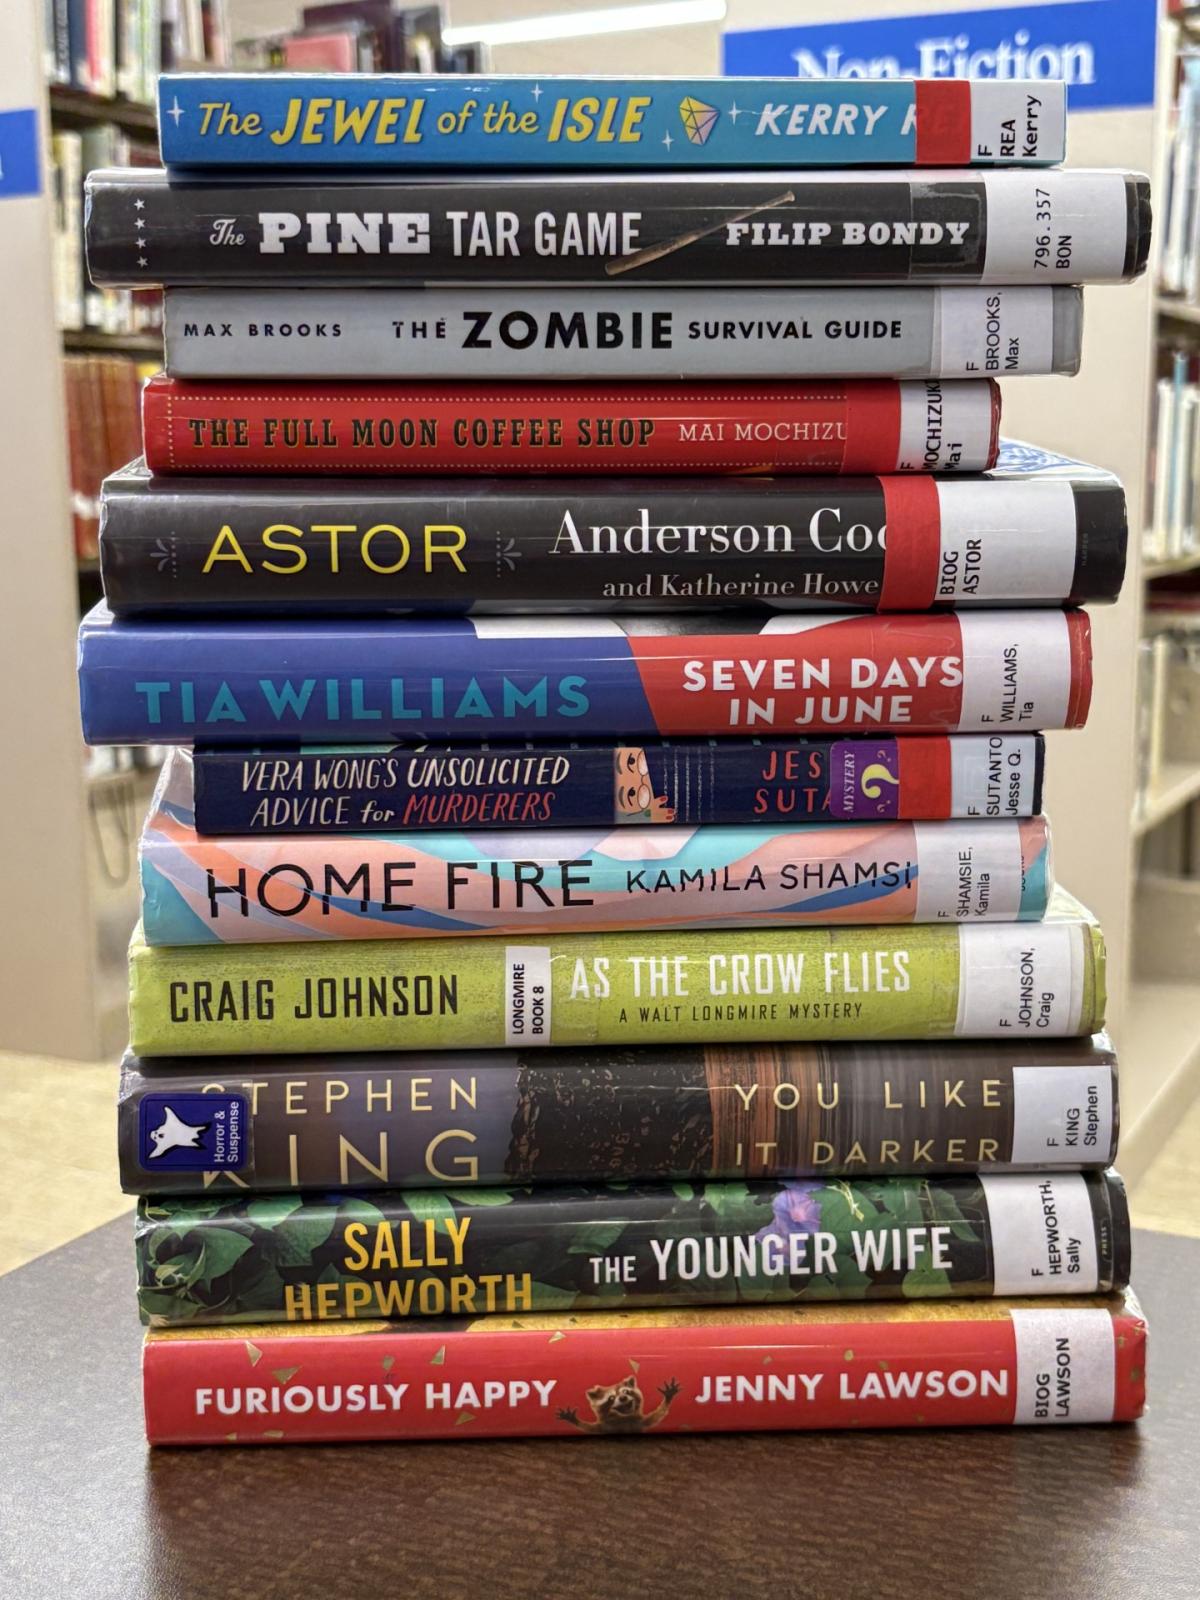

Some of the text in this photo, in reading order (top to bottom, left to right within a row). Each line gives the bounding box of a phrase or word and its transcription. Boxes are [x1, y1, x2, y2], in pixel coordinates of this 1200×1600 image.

[199, 96, 652, 145] The JEWEL of the ISLE
[755, 103, 888, 136] KERRY
[1001, 119, 1016, 157] REA
[1022, 94, 1042, 157] Kerry
[978, 144, 992, 157] F
[210, 211, 642, 257] The PINE TAR GAME
[726, 221, 969, 246] FILIP BONDY
[1034, 188, 1051, 269] 796.357
[1057, 235, 1071, 269] BON
[184, 323, 342, 337] MAX BROOKS
[392, 311, 901, 350] THE ZOMBIE SURVIVAL GUIDE
[986, 291, 1002, 371] BROOKS,
[966, 361, 979, 372] F
[1005, 337, 1019, 371] Max
[190, 418, 654, 448] THE FULL MOON COFFEE SHOP
[679, 423, 725, 441] MAI
[944, 443, 962, 470] Mai
[202, 524, 467, 575] ASTOR
[548, 508, 795, 555] Anderson
[603, 572, 879, 598] and Katherine Howe
[940, 551, 958, 596] BIOG
[964, 539, 982, 595] ASTOR
[682, 656, 963, 691] SEVEN DAYS
[1000, 644, 1019, 722] WILLIAMS,
[135, 676, 589, 723] TIA WILLIAMS
[730, 695, 912, 725] IN JUNE
[982, 714, 994, 722] F
[1018, 702, 1034, 722] Tia
[242, 756, 570, 792] VERA WONG'S UNSOLICITED
[843, 750, 855, 812] MYSTERY
[987, 736, 1003, 816] SUTANTO
[1006, 749, 1021, 816] Jesse Q.
[250, 793, 555, 827] ADVICE for MURDERERS
[968, 806, 980, 816] F
[206, 860, 594, 918] HOME FIRE
[626, 864, 765, 894] KAMILA
[957, 846, 973, 917] SHAMSIE,
[975, 873, 990, 917] Kamila
[570, 951, 910, 999] AS THE CROW FLIES
[1018, 948, 1035, 1028] JOHNSON,
[170, 974, 458, 1023] CRAIG JOHNSON
[512, 963, 525, 1035] LONGMIRE
[532, 986, 544, 1035] BOOK 8
[619, 1002, 863, 1023] A WALT LONGMIRE MYSTERY
[1036, 992, 1054, 1028] Craig
[1000, 1018, 1011, 1027] F
[733, 1079, 1001, 1111] YOU LIKE
[228, 1101, 239, 1163] Suspense
[1066, 1108, 1080, 1146] KING
[1084, 1085, 1098, 1146] Stephen
[214, 1110, 225, 1163] Horror &
[735, 1139, 1000, 1166] IT DARKER
[1047, 1138, 1058, 1146] F
[343, 1216, 472, 1271] SALLY
[1038, 1180, 1062, 1275] HEPWORTH,
[590, 1227, 953, 1284] THE YOUNGER WIFE
[1032, 1268, 1044, 1276] F
[1066, 1238, 1082, 1273] Sally
[284, 1273, 533, 1322] HEPWORTH
[195, 1379, 557, 1415] FURIOUSLY HAPPY
[696, 1369, 1007, 1403] JENNY LAWSON
[1035, 1373, 1050, 1418] BIOG
[1055, 1338, 1070, 1417] LAWSON
